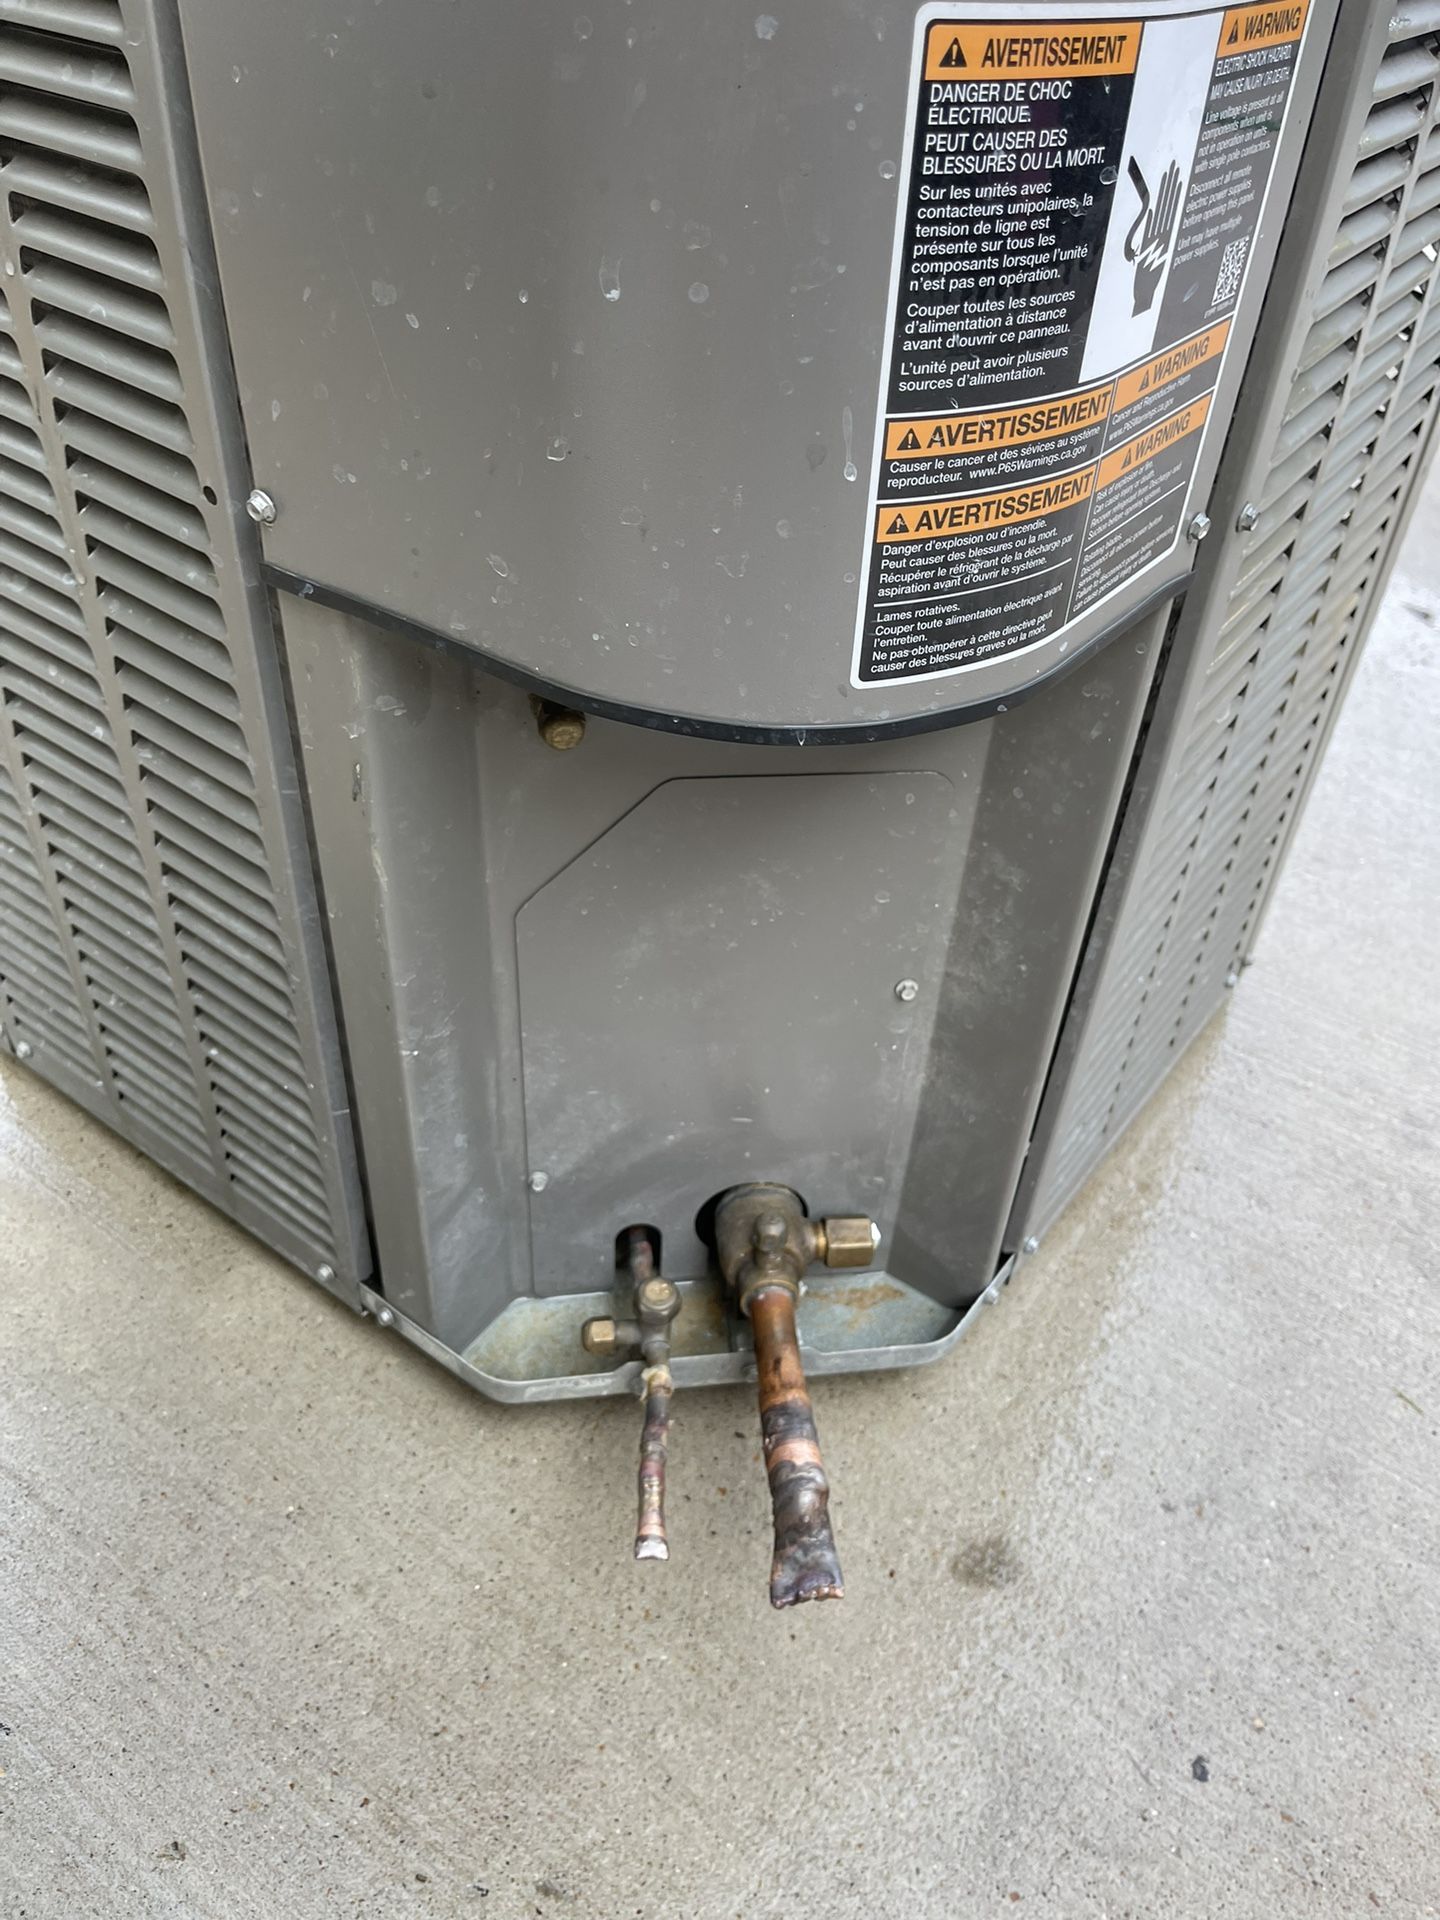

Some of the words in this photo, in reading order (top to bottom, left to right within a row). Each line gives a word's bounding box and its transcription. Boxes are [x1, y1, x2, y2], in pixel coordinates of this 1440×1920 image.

[1244, 7, 1302, 41] WARNING
[981, 36, 1128, 68] AVERTISSEMENT
[930, 83, 1000, 103] DANGER
[1004, 82, 1025, 101] DE
[1029, 80, 1072, 100] CHOC
[928, 104, 1032, 126] ÉLECTRIQUE.
[925, 133, 969, 152] PEUT
[972, 131, 1036, 151] CAUSER
[1039, 129, 1068, 148] DES
[922, 153, 1016, 175] BLESSURES
[1020, 152, 1043, 171] OU
[1045, 151, 1062, 169] LA
[1066, 147, 1106, 167] MORT.
[920, 185, 946, 200] Sur
[950, 185, 971, 200] les
[975, 182, 1017, 199] unités
[1021, 182, 1052, 196] avec
[917, 204, 1004, 219] contacteurs
[1007, 197, 1079, 216] unipolaires,
[1083, 193, 1093, 206] la
[916, 223, 969, 238] tension
[973, 221, 991, 235] de
[995, 218, 1027, 236] ligne
[1031, 216, 1051, 229] est
[913, 240, 977, 259] présente
[981, 240, 1004, 252] sur
[1006, 236, 1034, 250] tous
[1038, 233, 1056, 246] les
[911, 257, 999, 275] composants
[1003, 251, 1049, 270] lorsque
[949, 276, 975, 292] pas
[979, 275, 995, 287] en
[999, 267, 1061, 289] opération.
[907, 303, 959, 319] Couper
[963, 299, 1005, 315] toutes
[1008, 296, 1026, 310] les
[1030, 289, 1076, 307] sources
[1005, 313, 1013, 326] à
[1017, 307, 1067, 325] distance
[903, 337, 942, 351] avant
[1000, 330, 1015, 343] ce
[1018, 322, 1071, 343] panneau.
[950, 357, 980, 374] peut
[984, 354, 1015, 369] avoir
[1017, 345, 1069, 366] plusieurs
[1153, 336, 1210, 384] WARNING
[898, 377, 953, 391] sources
[927, 390, 1111, 449] AVERTISSEMENT
[1136, 411, 1191, 461] WARNING
[887, 472, 963, 489] reproducteur.
[969, 444, 1087, 479] www.P65Warnings.ca.gov
[890, 459, 931, 474] Causer
[934, 458, 945, 469] le
[948, 454, 984, 468] cancer
[987, 451, 998, 462] et
[1000, 447, 1018, 460] des
[1021, 440, 1055, 457] sévices
[1057, 439, 1068, 449] au
[914, 471, 1094, 532] AVERTISSEMENT
[881, 558, 907, 570] Peut
[910, 554, 945, 566] causer
[948, 551, 966, 562] des
[969, 541, 1013, 558] blessures
[1015, 538, 1027, 548] ou
[1029, 535, 1036, 544] la
[1038, 528, 1058, 542] mort.
[882, 542, 923, 556] Danger
[986, 531, 998, 541] ou
[879, 569, 934, 585] Récupérer
[937, 567, 947, 577] le
[949, 558, 999, 576] réfrigérant
[1001, 554, 1013, 565] de
[1014, 551, 1023, 561] la
[1024, 539, 1061, 558] décharge
[1060, 534, 1074, 548] par
[878, 583, 931, 598] aspiration
[933, 576, 962, 590] avant
[1001, 566, 1009, 576] le
[875, 625, 915, 638] Couper
[917, 620, 943, 631] toute
[945, 607, 1001, 626] alimentation
[1003, 593, 1043, 613] électrique
[1043, 583, 1063, 598] avant
[876, 612, 912, 623] Lames
[915, 604, 960, 618] rotatives.
[870, 661, 906, 673] causer
[909, 657, 927, 668] des
[929, 649, 974, 665] blessures
[976, 639, 1005, 656] graves
[1007, 636, 1018, 645] ou
[1020, 632, 1027, 641] la
[1028, 624, 1047, 637] mort.
[872, 651, 887, 661] Ne
[890, 649, 909, 661] pas
[912, 638, 967, 656] obtempérer
[969, 636, 976, 644] à
[978, 630, 1000, 643] cette
[1002, 617, 1036, 635] directive
[1037, 610, 1053, 625] peut
